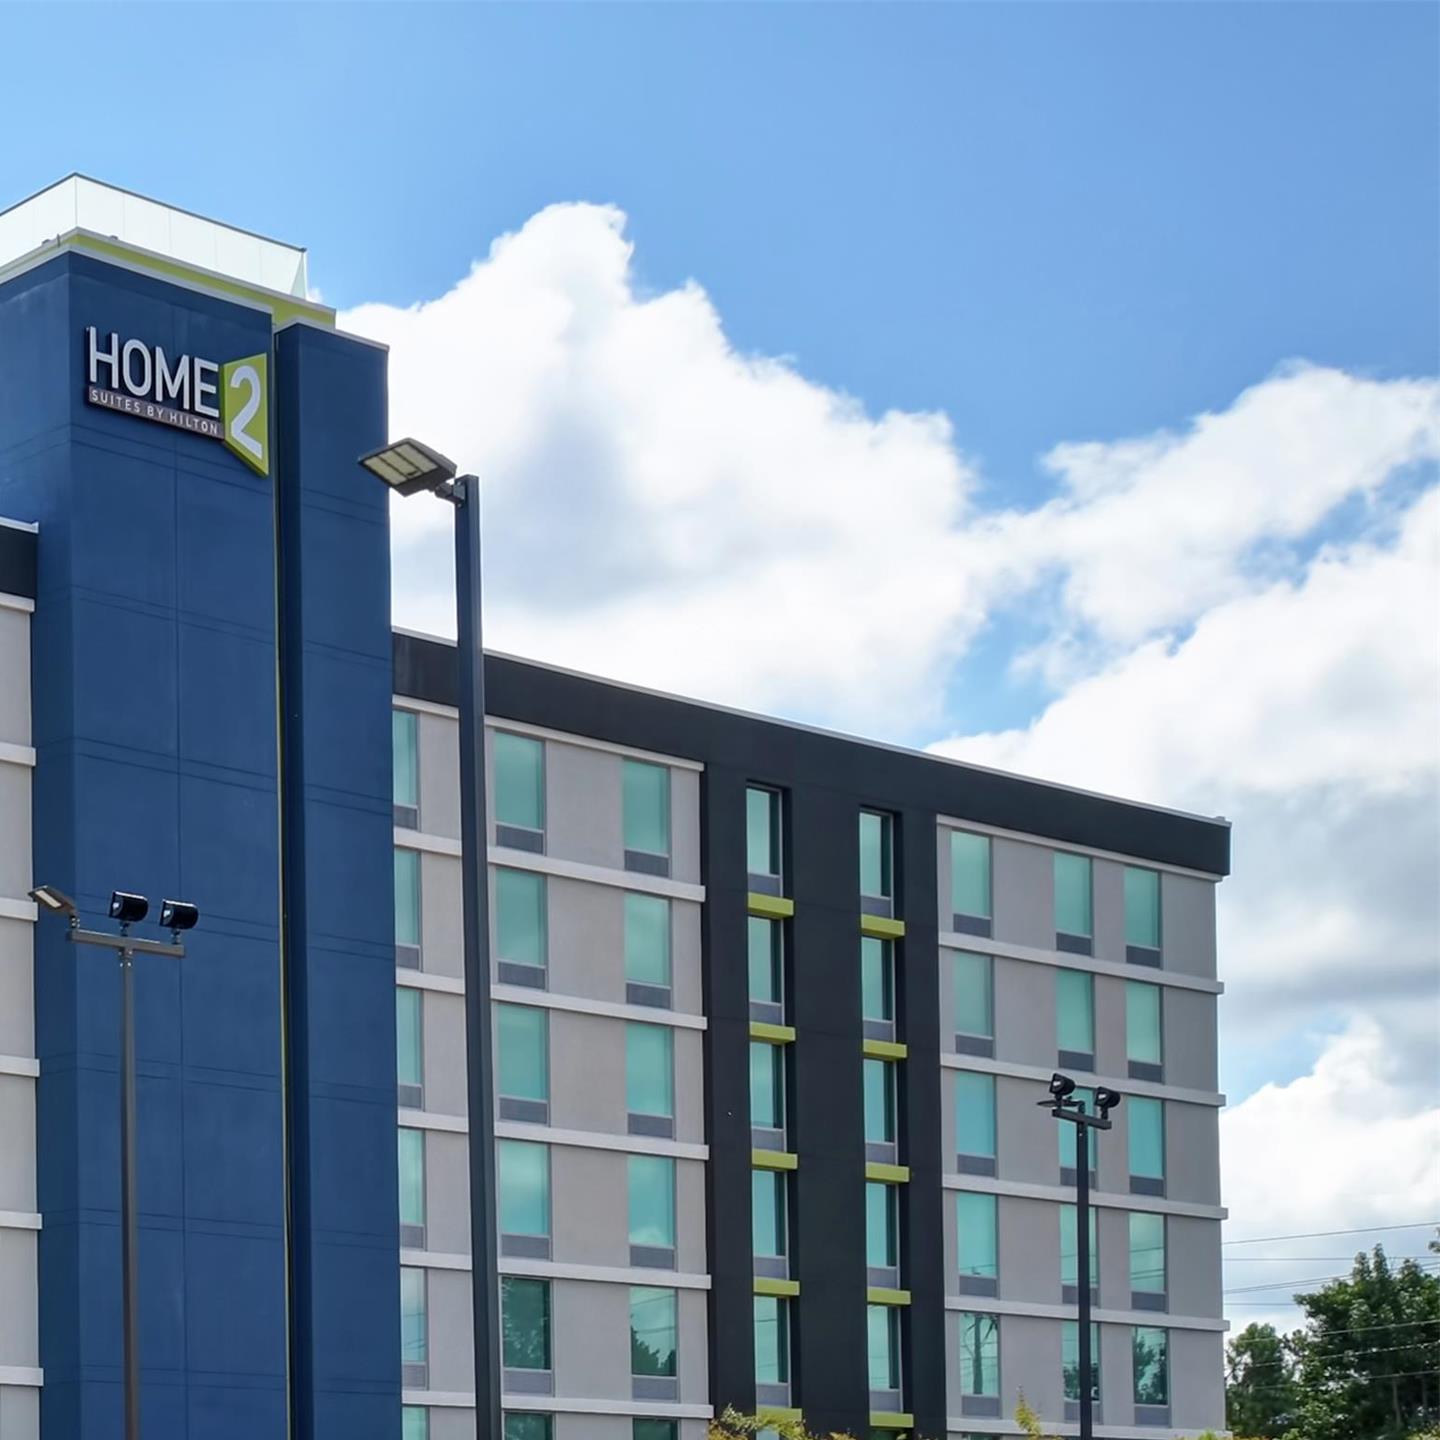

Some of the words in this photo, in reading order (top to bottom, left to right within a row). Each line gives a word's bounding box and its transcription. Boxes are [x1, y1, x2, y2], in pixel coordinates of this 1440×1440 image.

[91, 389, 141, 413] SUITES
[147, 405, 164, 422] BY
[170, 410, 219, 435] HILTON
